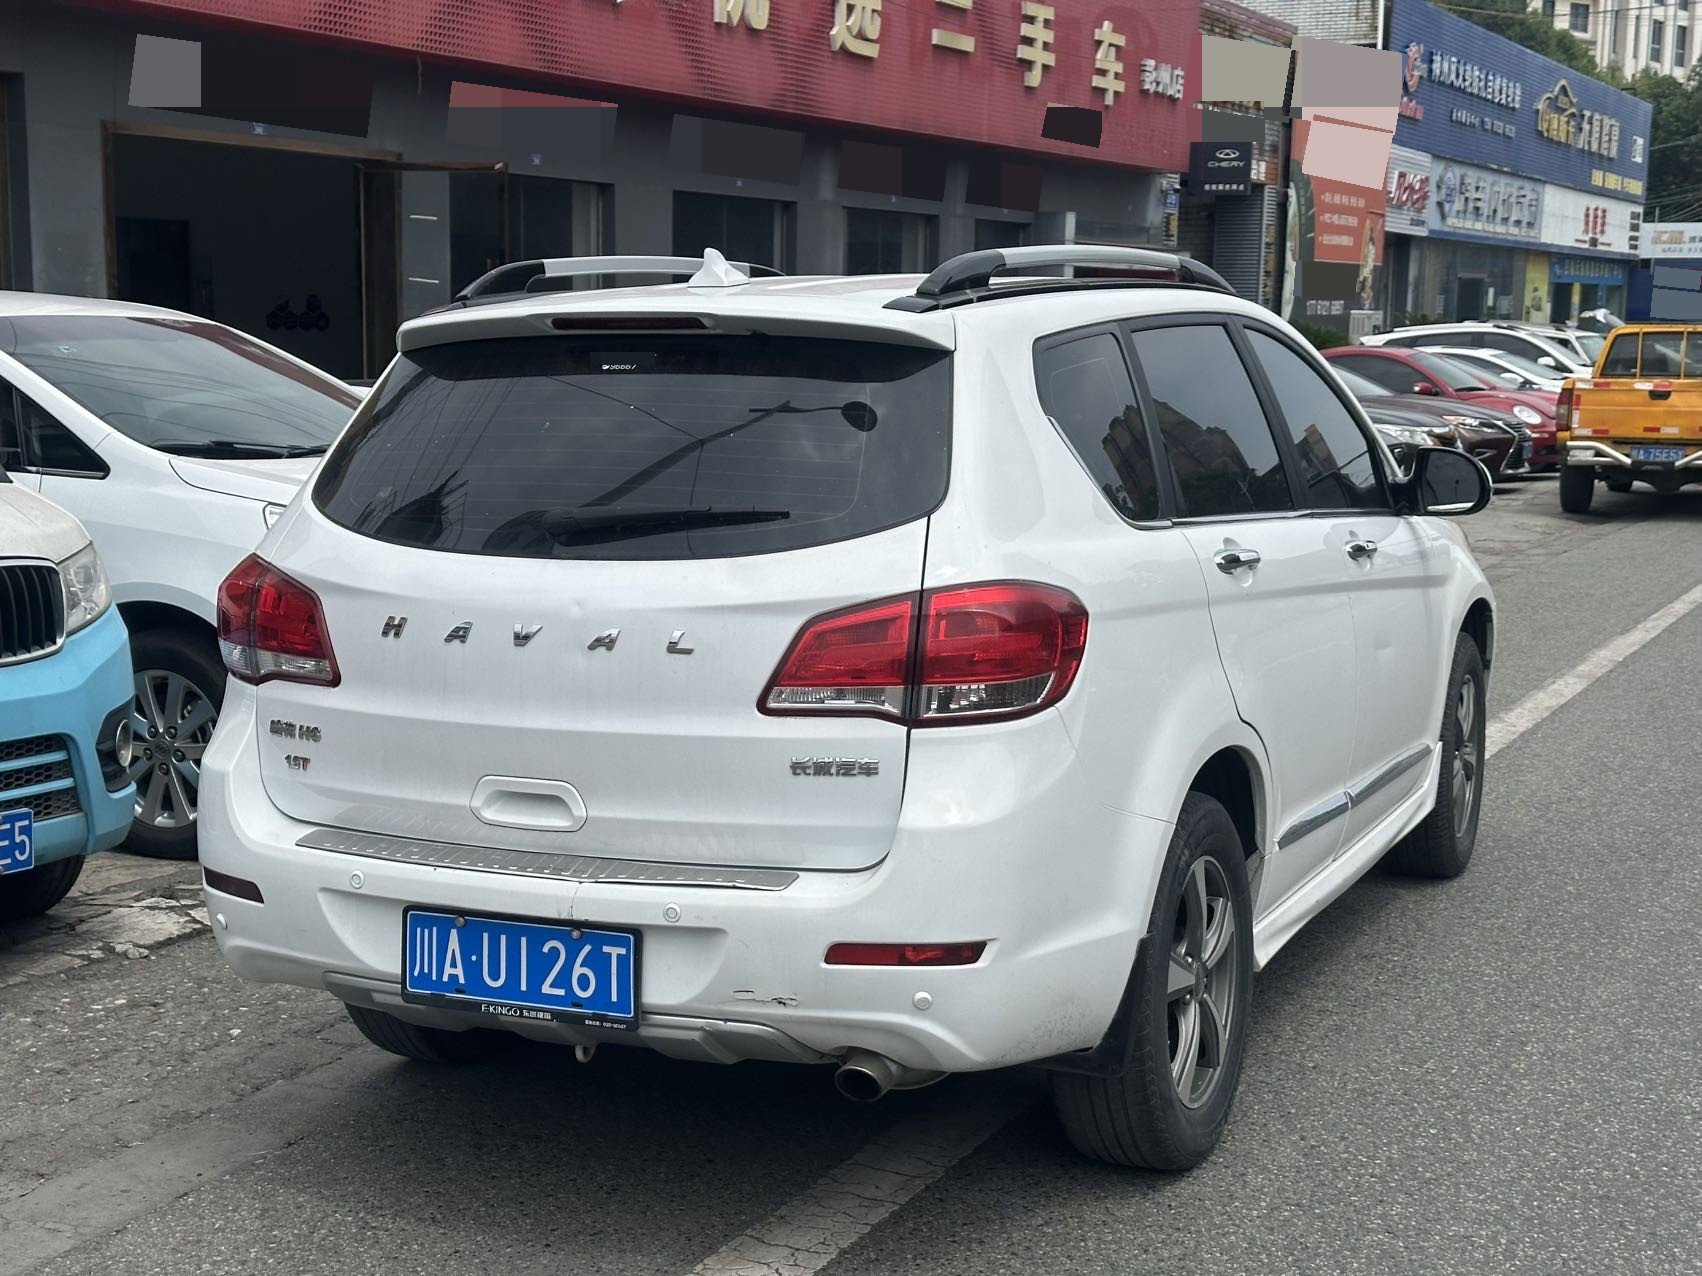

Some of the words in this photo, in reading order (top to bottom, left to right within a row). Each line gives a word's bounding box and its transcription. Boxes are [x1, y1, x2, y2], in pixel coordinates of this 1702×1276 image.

[381, 615, 695, 655] HAVAL
[298, 724, 321, 742] H6
[789, 756, 880, 777] 长城汽车
[413, 926, 627, 1003] 川A·U126T
